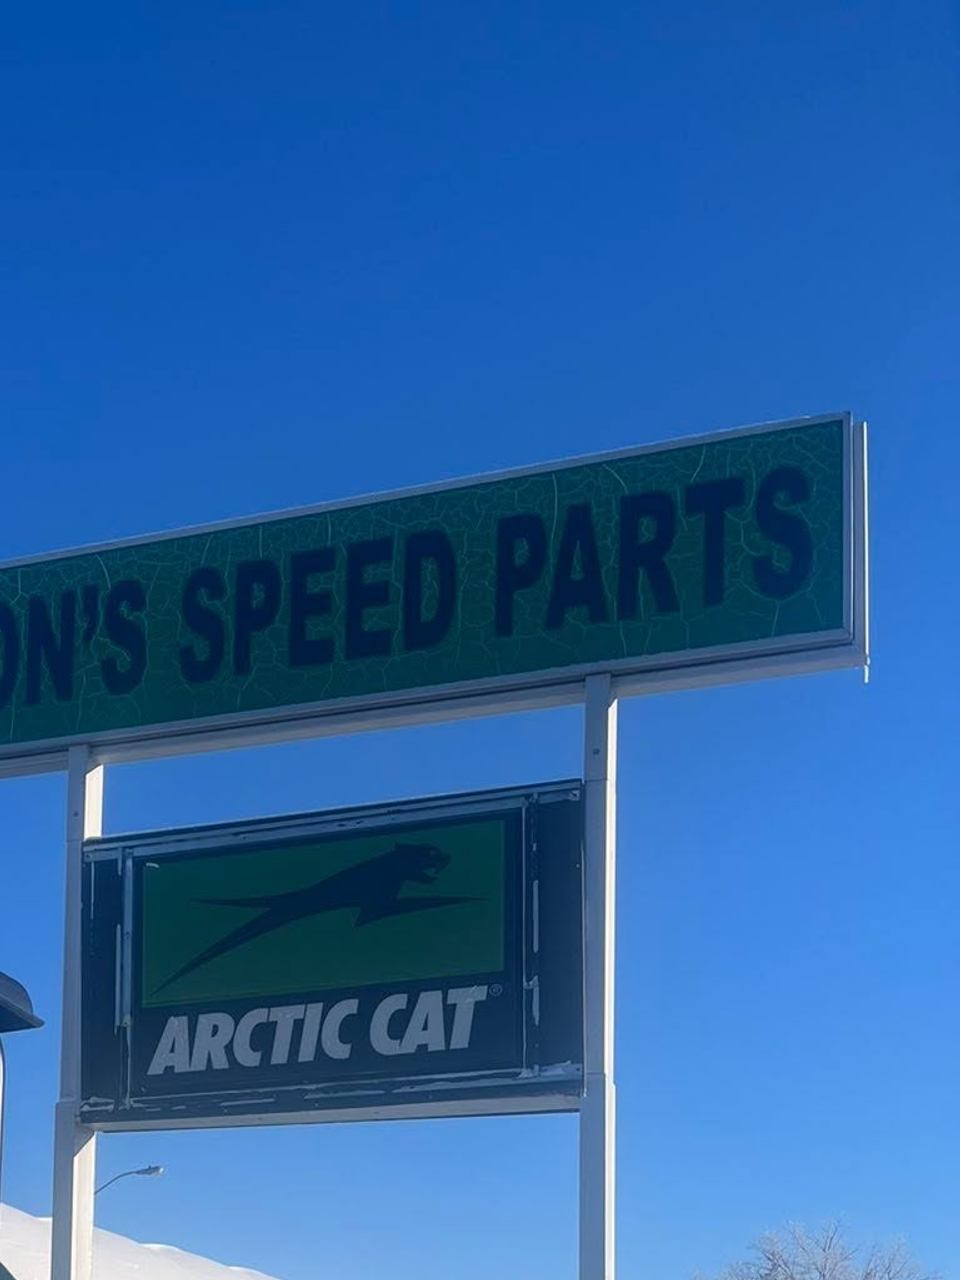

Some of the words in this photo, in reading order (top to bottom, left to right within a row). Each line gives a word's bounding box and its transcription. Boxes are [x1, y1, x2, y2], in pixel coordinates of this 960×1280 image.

[180, 531, 455, 683] SPEED
[494, 467, 814, 638] PARTS
[147, 1000, 357, 1075] ARCTIC
[370, 986, 487, 1057] CAT
